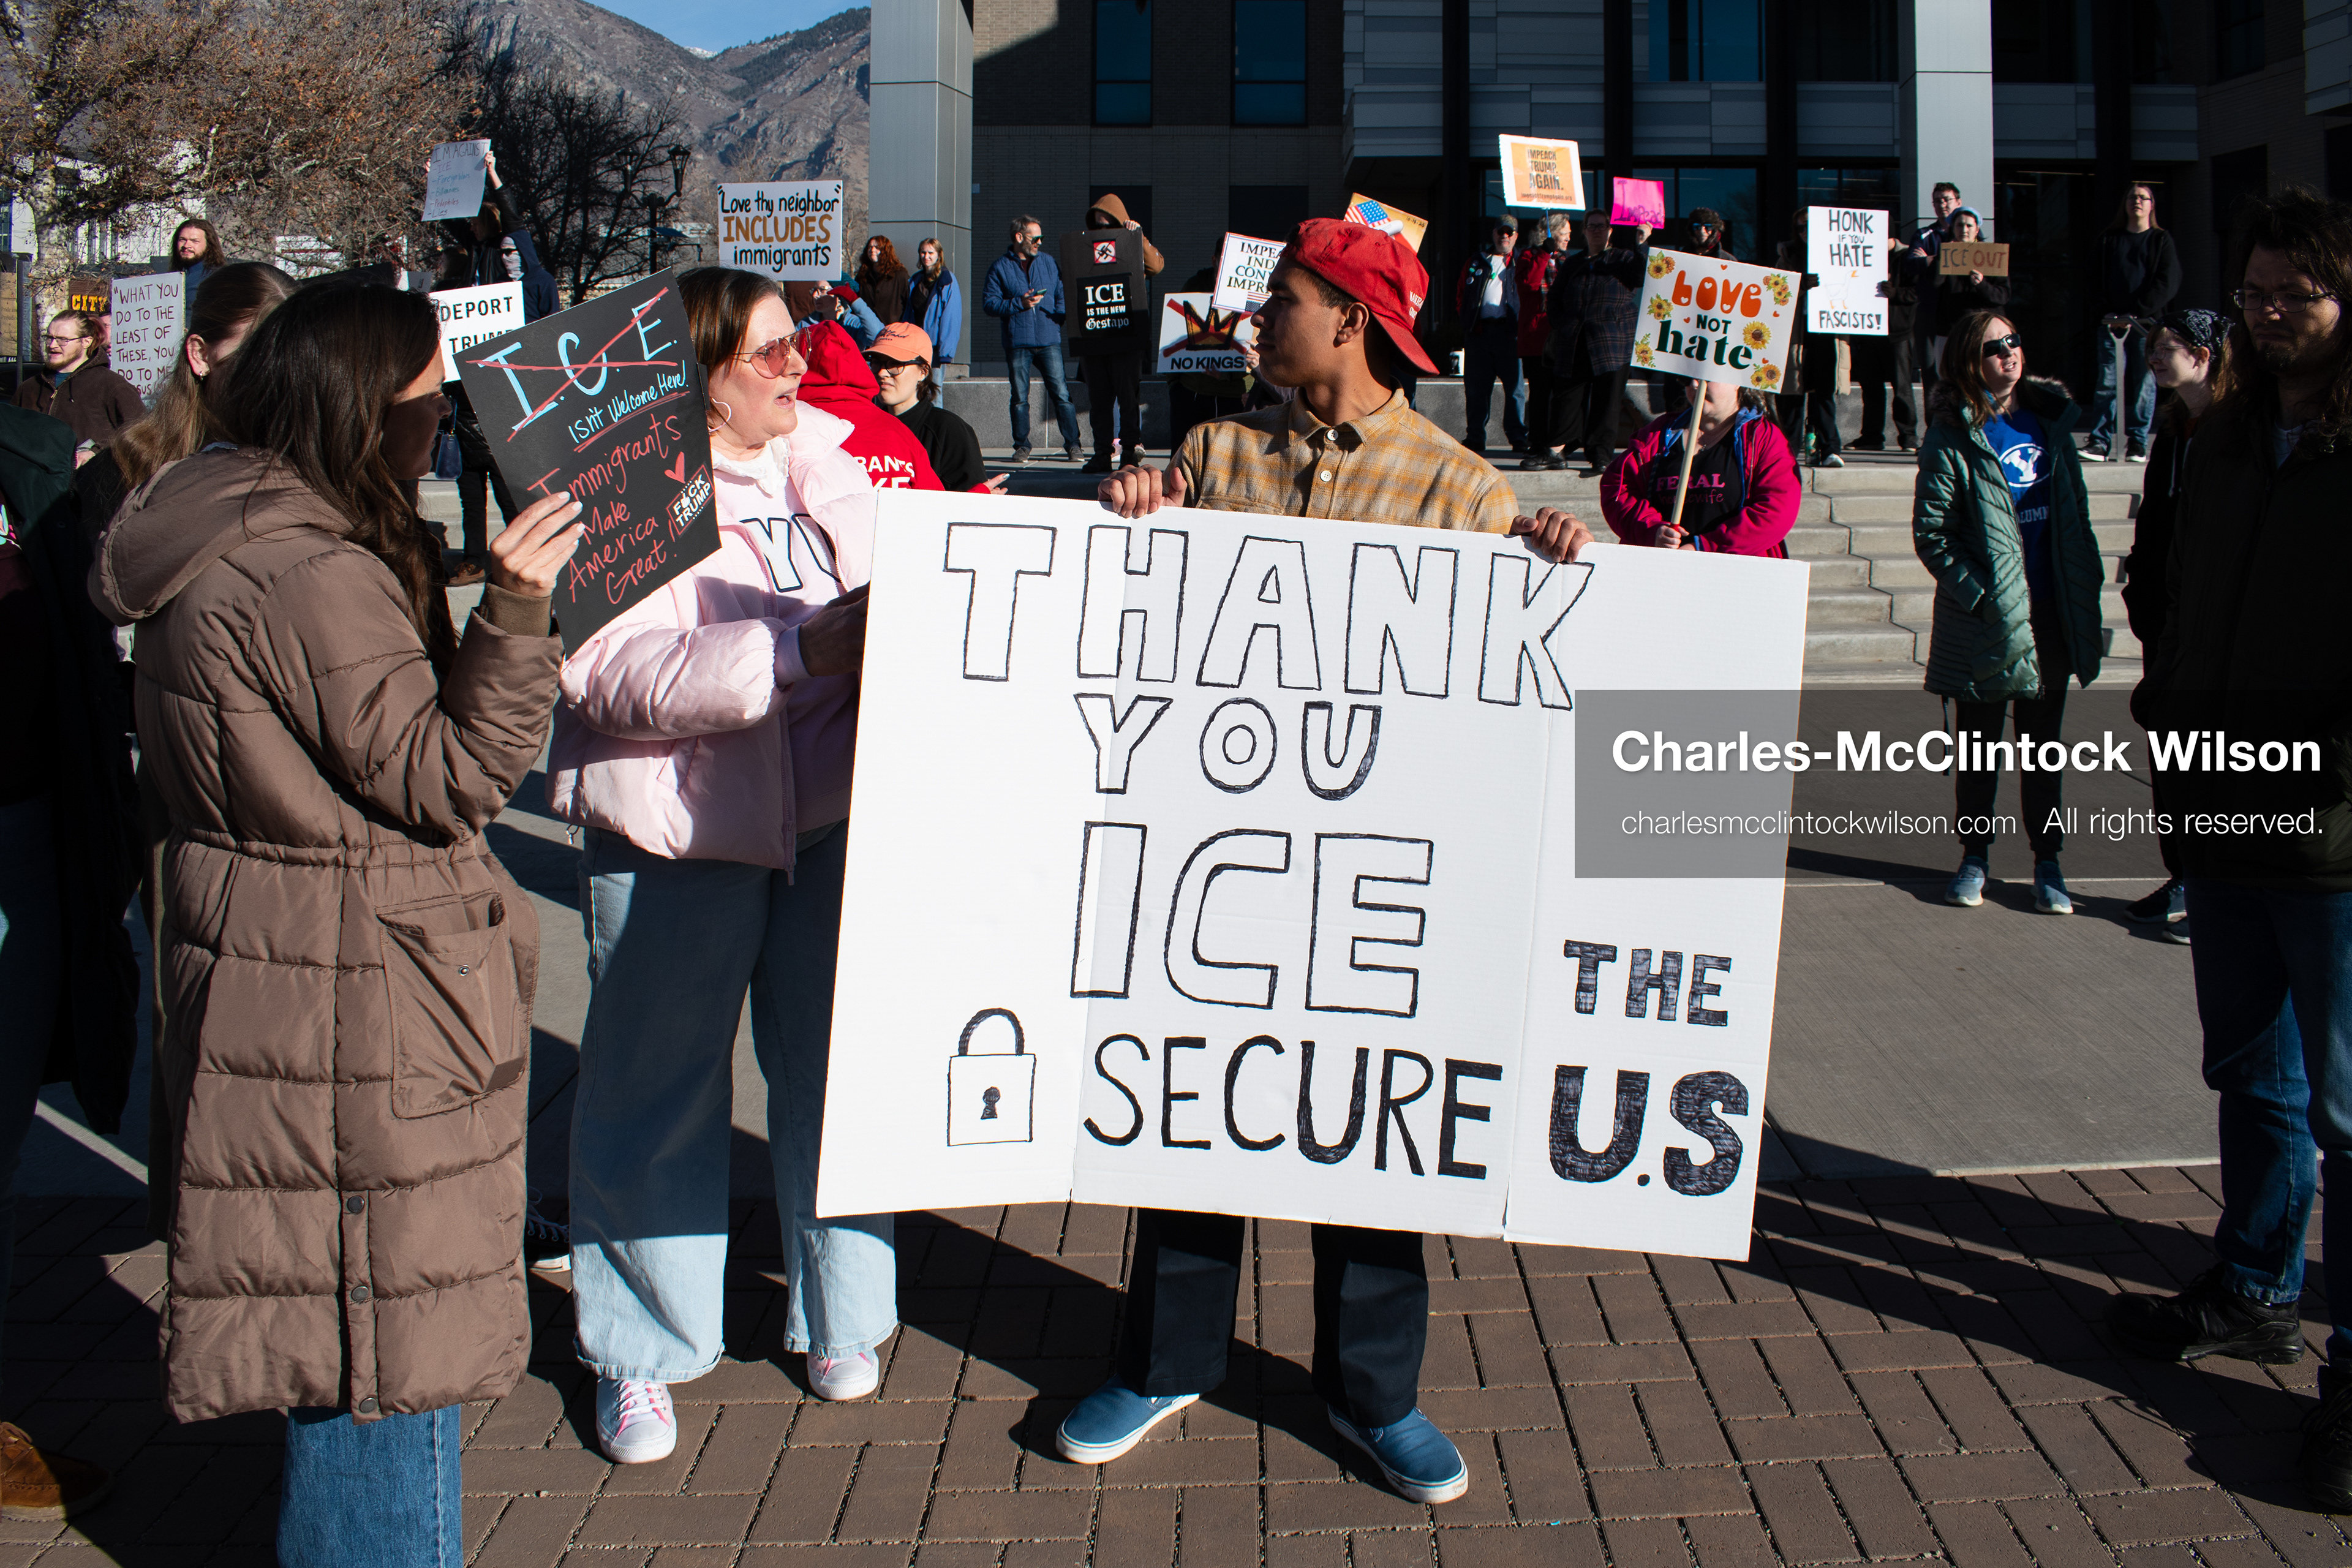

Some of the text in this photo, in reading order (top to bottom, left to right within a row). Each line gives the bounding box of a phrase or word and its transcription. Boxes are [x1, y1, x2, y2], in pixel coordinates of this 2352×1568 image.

[453, 142, 489, 159] AGAINST
[1528, 149, 1556, 160] IMPEACH
[1529, 173, 1564, 190] AGAIN.
[755, 190, 774, 218] thy
[723, 214, 833, 244] INCLUDES
[1829, 209, 1873, 234] HONK
[1848, 234, 1865, 244] YOU
[734, 243, 832, 273] immigrants
[1830, 243, 1873, 267] HATE
[1942, 247, 2007, 269] ICE OUT
[156, 283, 178, 299] YOU
[1085, 283, 1125, 305] ICE
[72, 294, 107, 312] CITY
[440, 296, 513, 322] DEPORT
[1096, 307, 1109, 315] THE
[1110, 305, 1126, 314] NEW
[116, 306, 175, 326] DO TO THE
[1085, 317, 1129, 330] Gestapo
[1697, 314, 1732, 334] NOT
[1819, 310, 1882, 330] FASCISTS!
[116, 325, 172, 344] LEAST OF
[1655, 319, 1752, 370] hate
[116, 345, 175, 363] THESE, YOU
[1170, 356, 1245, 370] NO KINGS
[118, 369, 133, 380] DO
[137, 368, 152, 381] TO
[676, 482, 711, 527] TRUMP
[579, 502, 630, 545] Make
[570, 517, 658, 603] America
[943, 522, 1595, 710] THANK
[1074, 693, 1382, 801] YOU
[1071, 821, 1433, 1017] ICE
[1564, 940, 1732, 1026] THE
[1083, 1034, 1503, 1180] SECURE
[1549, 1065, 1749, 1197] U.S
